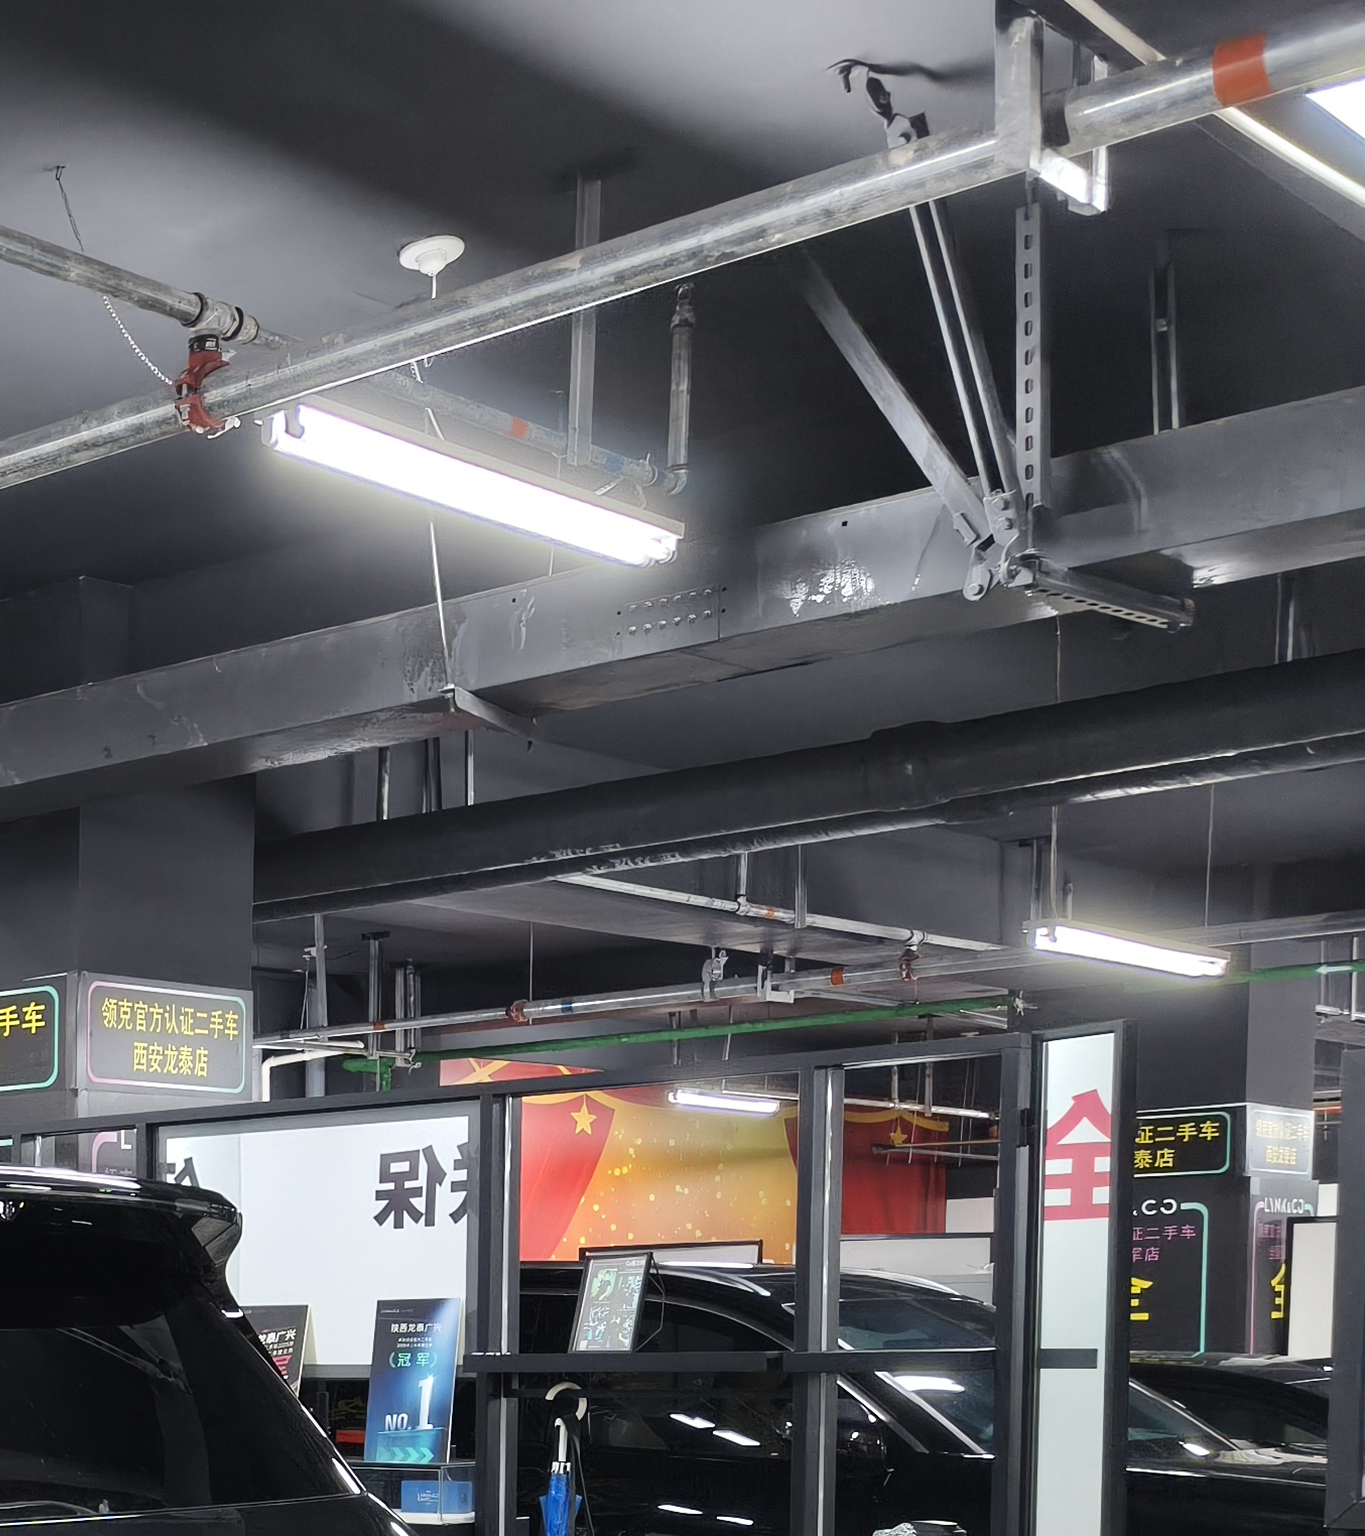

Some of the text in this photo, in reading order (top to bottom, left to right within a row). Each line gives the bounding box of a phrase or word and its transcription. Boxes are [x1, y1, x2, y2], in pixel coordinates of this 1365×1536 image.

[101, 996, 240, 1042] 领克官方认证二手车
[132, 1041, 210, 1078] 西安龙泰店
